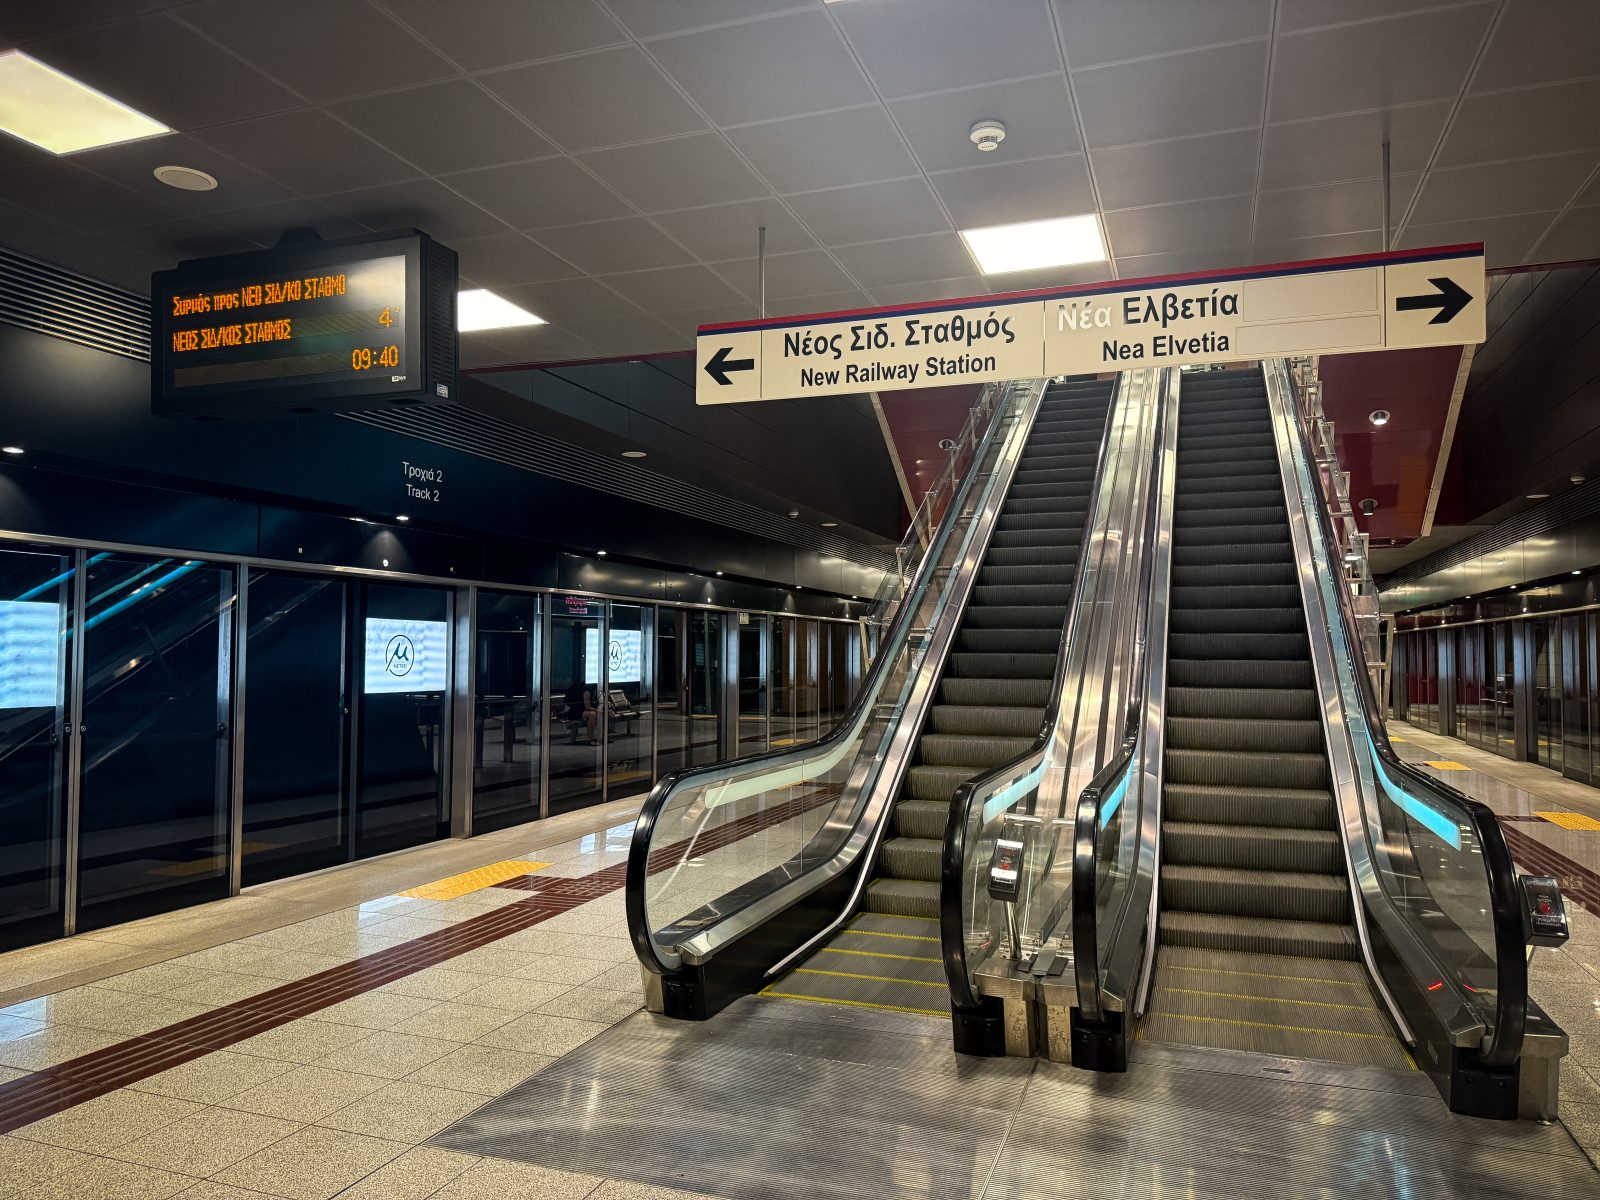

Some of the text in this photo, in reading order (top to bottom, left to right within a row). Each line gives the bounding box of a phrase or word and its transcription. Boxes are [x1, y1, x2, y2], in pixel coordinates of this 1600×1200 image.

[173, 274, 346, 316] Συρμός προς ΝΕΟ ΣΙΔ/ΚΟ ΣΤΑΘΜΟ
[1058, 288, 1238, 332] Νέα Ελβετία
[173, 319, 291, 352] ΝΕΟΣ ΣΙΔ/ΚΟΣ ΣΤΑΘΜΟΣ
[783, 311, 1016, 359] Νέος Σιδ. Σταθμός
[1102, 331, 1230, 362] Nea Elvetia
[352, 345, 399, 370] 09:40
[800, 354, 996, 387] New Railway Station
[402, 461, 442, 482] Τροχιά 2
[406, 483, 439, 501] Track 2
